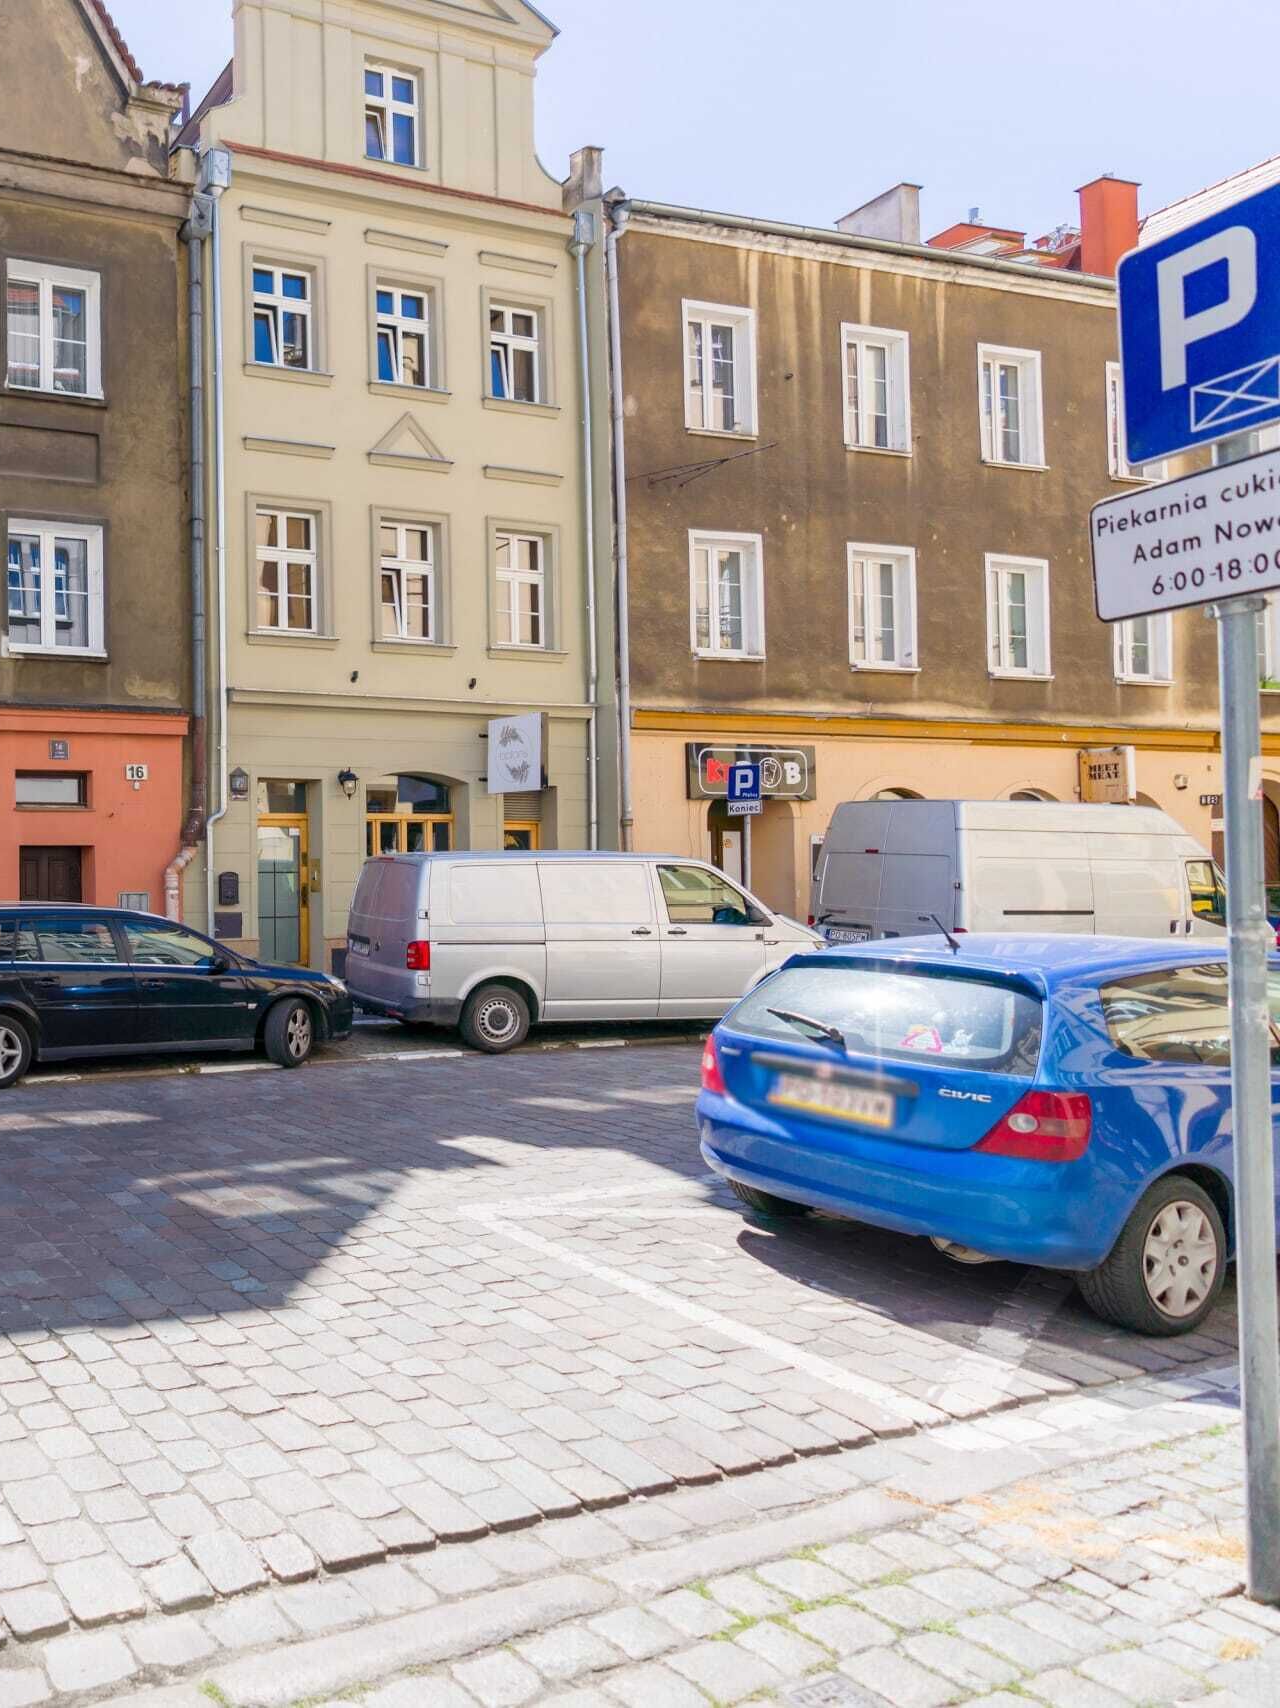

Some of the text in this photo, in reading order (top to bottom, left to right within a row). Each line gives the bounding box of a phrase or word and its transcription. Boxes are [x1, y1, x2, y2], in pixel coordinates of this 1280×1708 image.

[1157, 225, 1258, 392] P
[1096, 468, 1280, 537] Piekarnia cuki
[1133, 535, 1202, 564] Adam
[127, 765, 144, 779] 16
[1088, 763, 1120, 773] MEET
[1088, 771, 1121, 781] MEAT
[735, 769, 754, 796] P
[729, 802, 759, 813] Koniec
[938, 1088, 992, 1104] CIVIC
